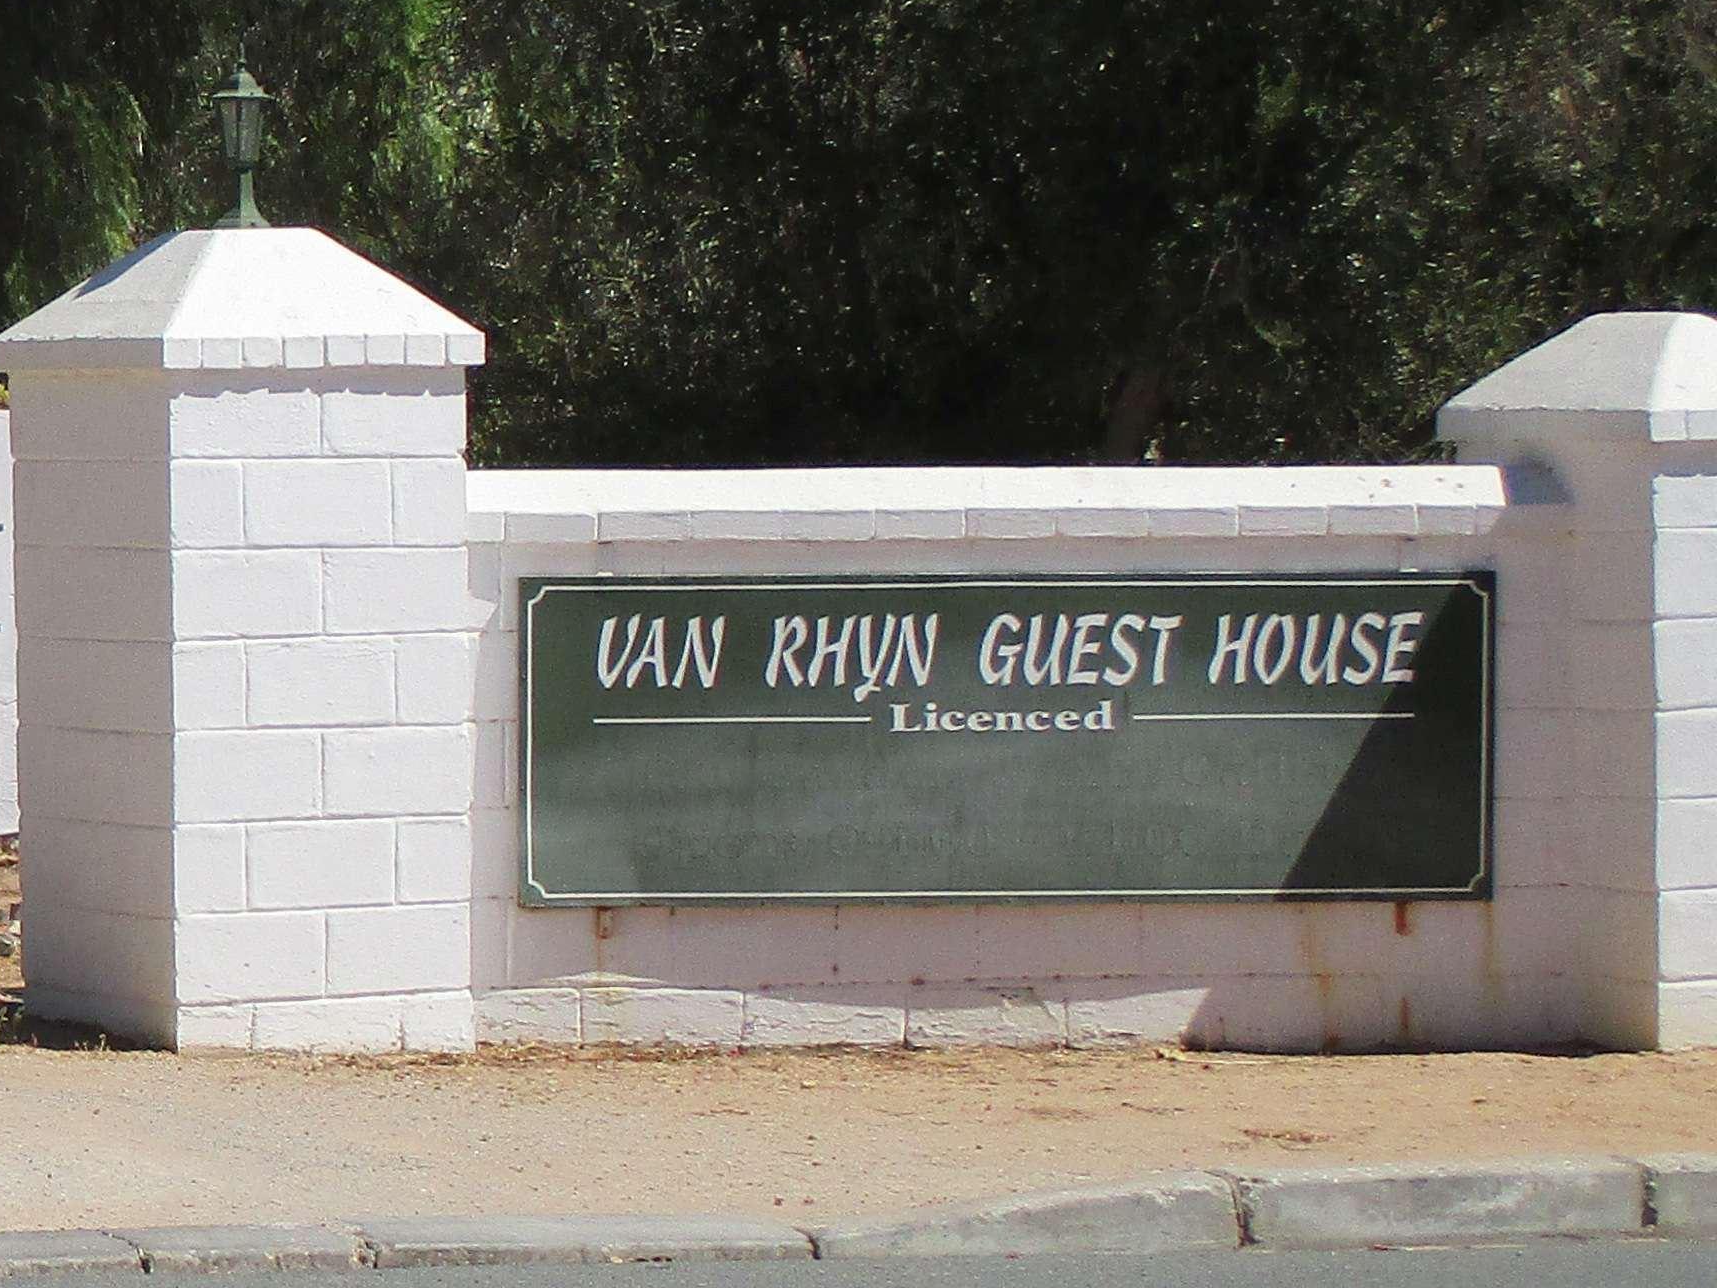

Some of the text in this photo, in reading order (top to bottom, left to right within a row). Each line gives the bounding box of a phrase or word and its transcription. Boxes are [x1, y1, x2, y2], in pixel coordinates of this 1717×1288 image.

[595, 611, 1424, 702] VAN RHYN GUEST HOUSE
[891, 701, 1115, 733] Licenced
